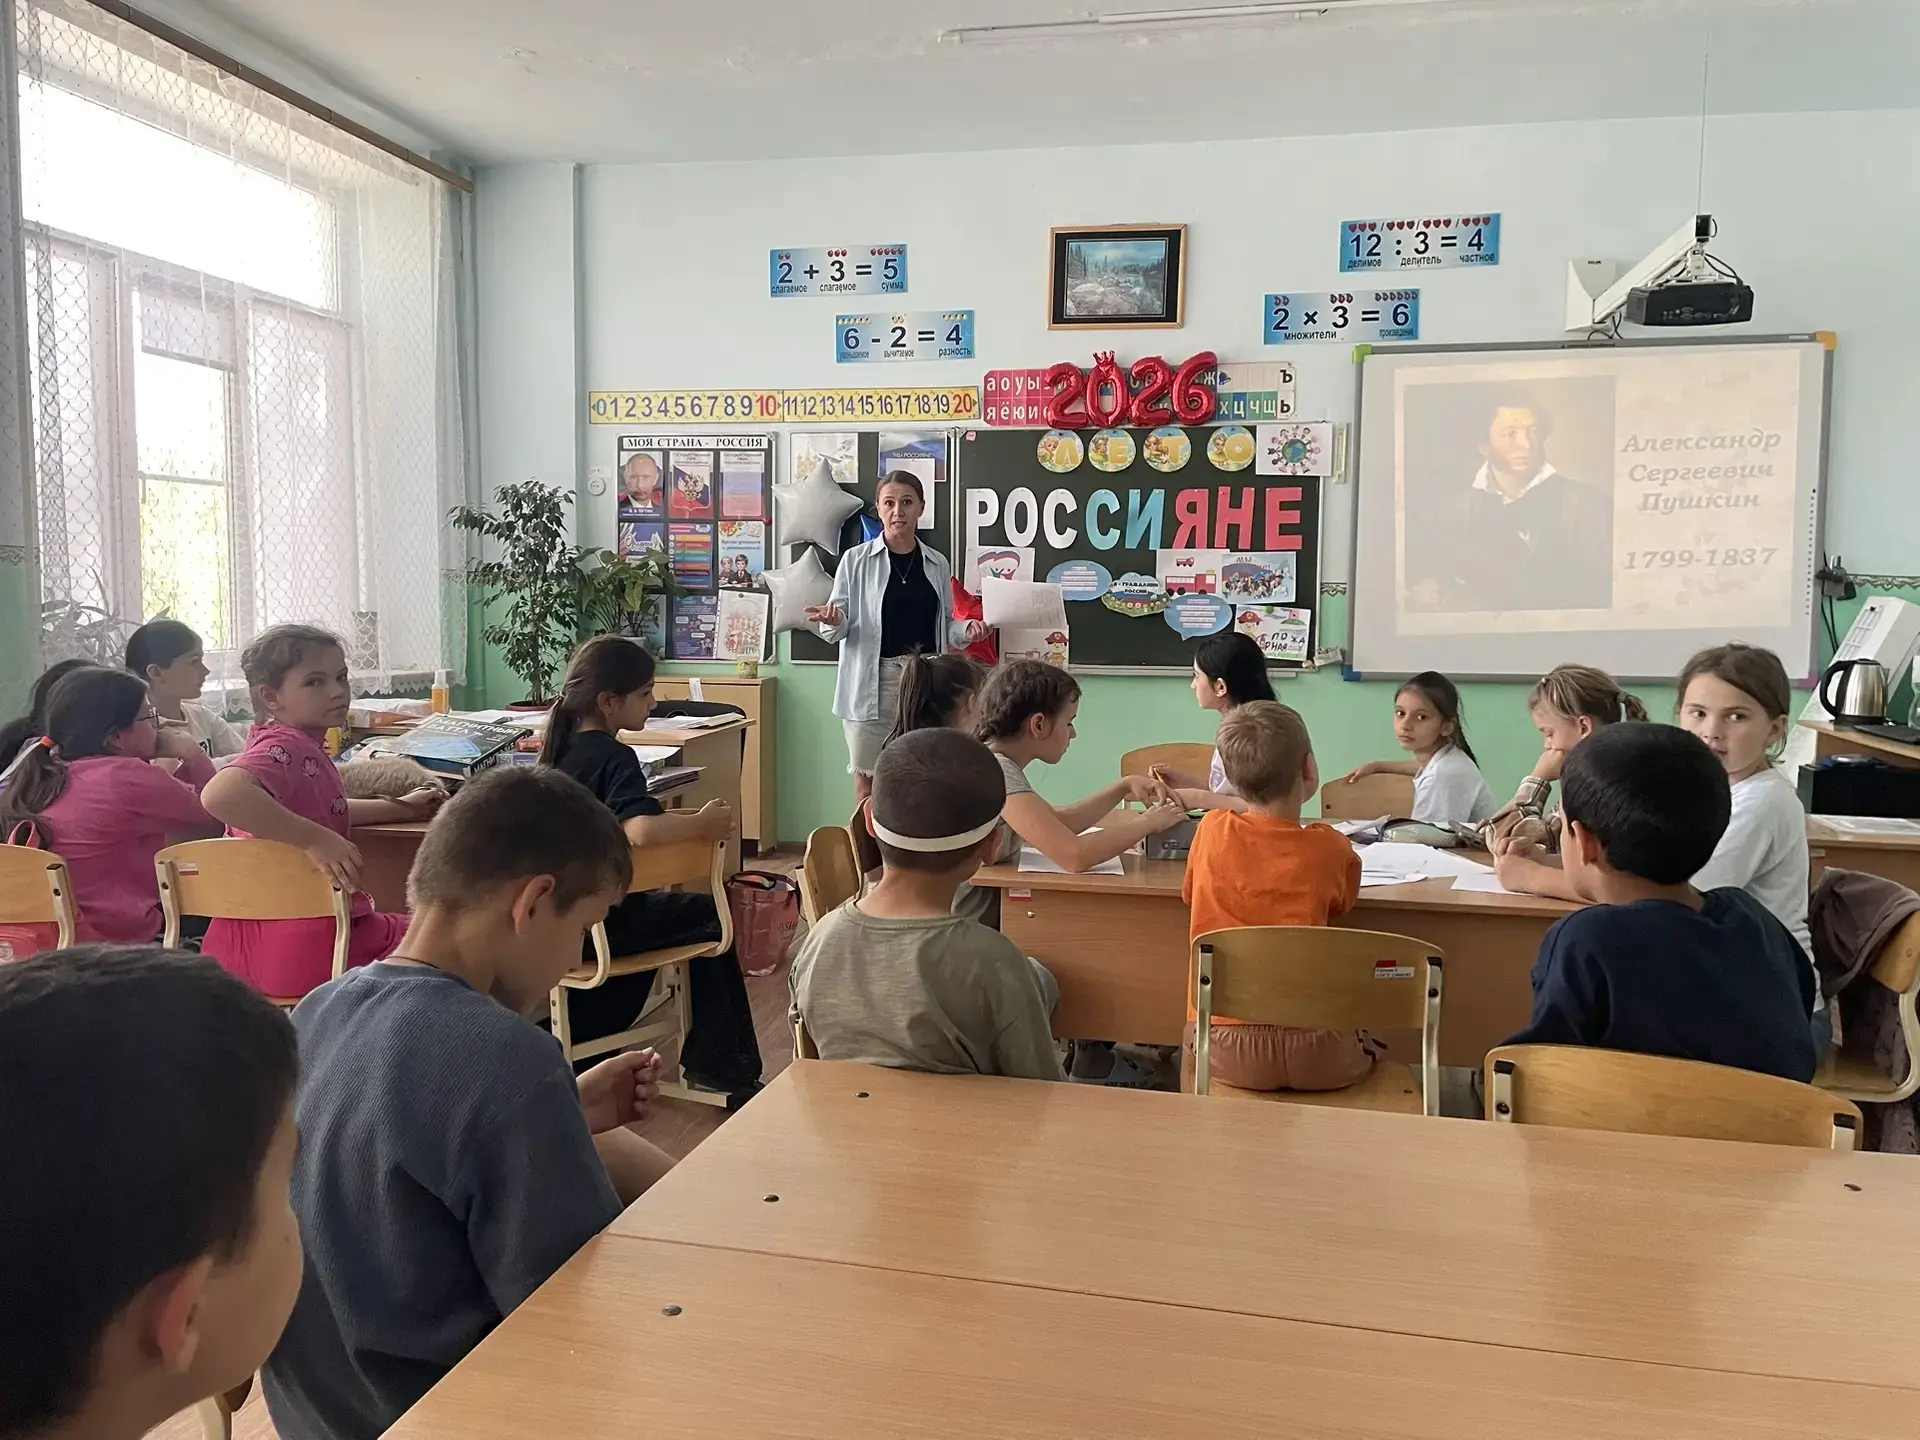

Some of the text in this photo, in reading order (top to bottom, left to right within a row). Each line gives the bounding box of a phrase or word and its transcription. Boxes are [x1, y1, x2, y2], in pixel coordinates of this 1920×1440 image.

[1350, 233, 1381, 257] 12
[1414, 231, 1429, 254] 3
[1467, 228, 1484, 251] 4
[778, 262, 793, 283] 2
[830, 260, 845, 282] 3
[883, 258, 898, 280] 5
[1348, 253, 1495, 269] делимое делитель частное
[771, 281, 903, 293] слагаемое слагаемое сумма
[1272, 308, 1289, 330] 2
[1332, 306, 1349, 328] 3
[1392, 303, 1409, 326] 6
[844, 328, 860, 349] 6
[890, 326, 906, 348] 2
[945, 324, 962, 345] 4
[1284, 331, 1337, 340] множители
[939, 348, 971, 358] разность
[1045, 350, 1218, 429] 2026
[627, 438, 653, 447] МОЯ
[657, 438, 702, 447] СТРАНА
[716, 437, 763, 447] РОССИЯ
[1620, 427, 1782, 454] Александр
[1628, 463, 1775, 487] Сергеевич
[1638, 492, 1760, 515] Пушкин
[966, 488, 1302, 550] РОССИЯНЕ
[1623, 547, 1778, 570] 1799-1837
